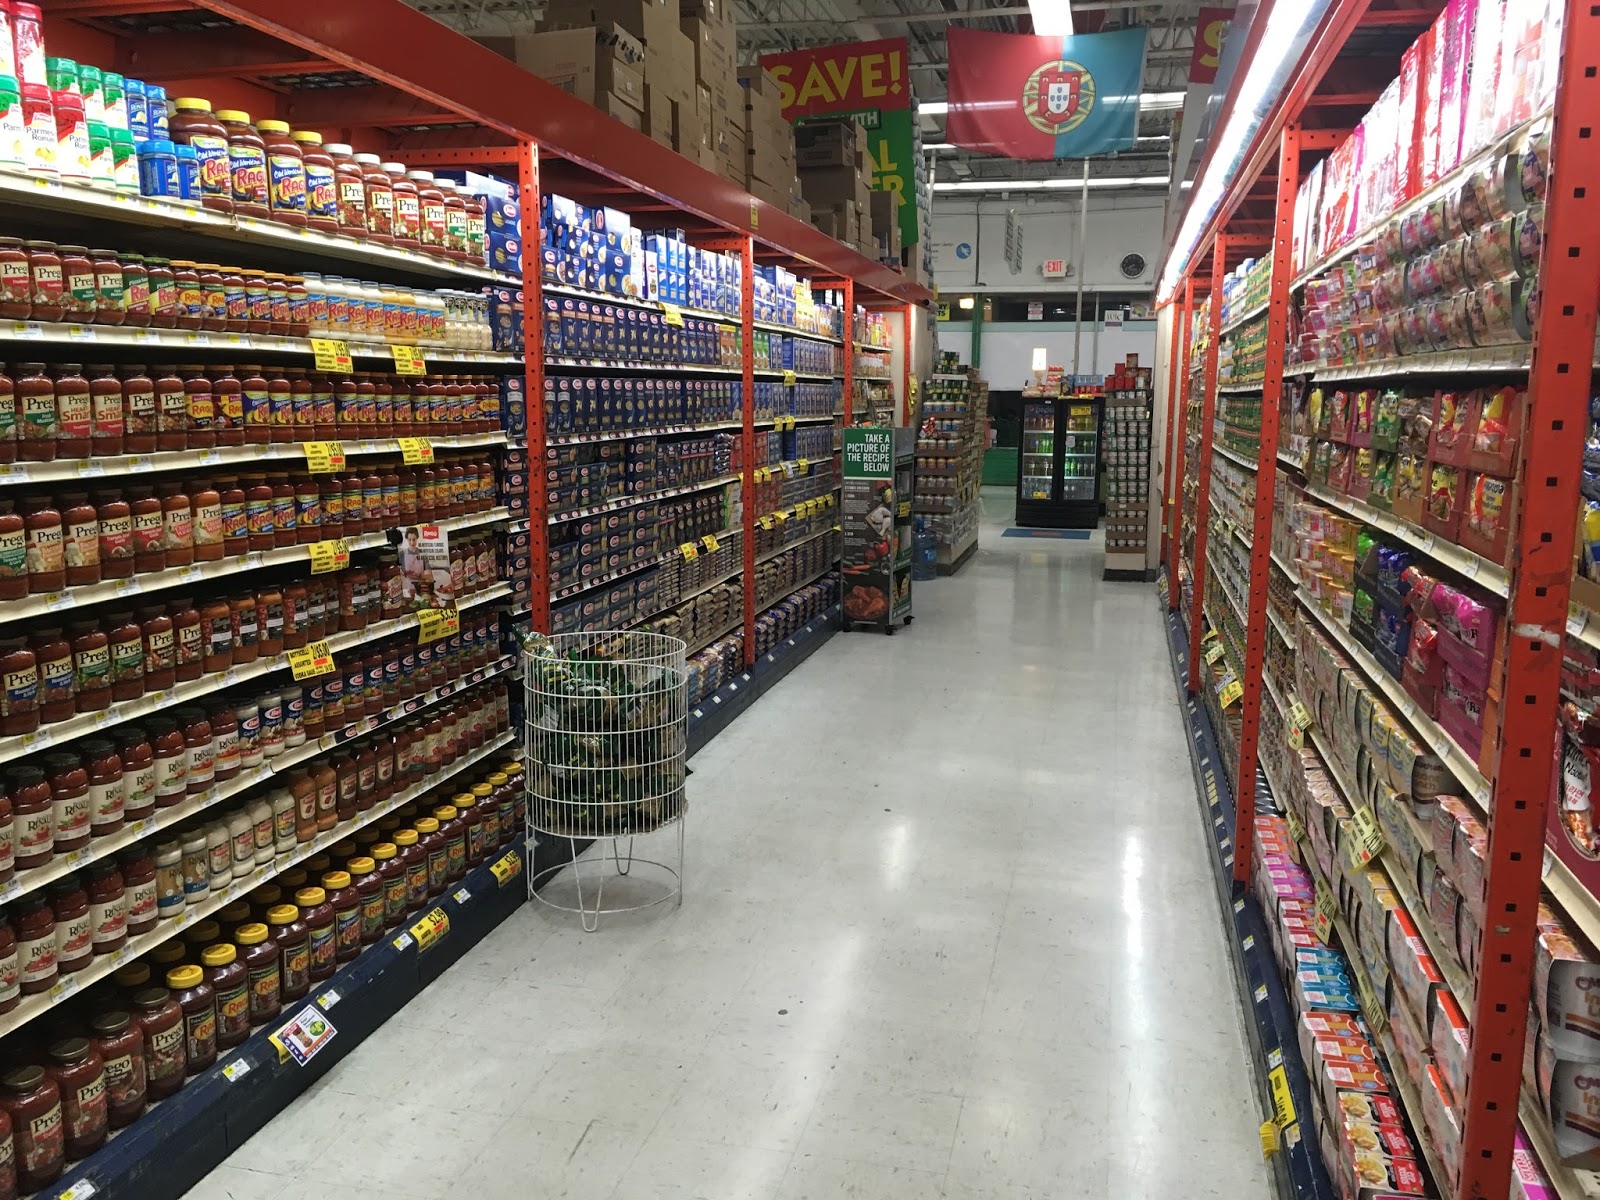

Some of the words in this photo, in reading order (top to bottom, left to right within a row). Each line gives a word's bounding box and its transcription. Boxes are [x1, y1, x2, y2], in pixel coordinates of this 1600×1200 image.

[767, 51, 902, 109] SAVE!
[1047, 261, 1063, 272] EXIT
[865, 433, 883, 443] TAKE
[884, 433, 890, 443] A
[847, 443, 879, 453] PICTURE
[880, 443, 890, 453] OF
[847, 453, 862, 462] THE
[863, 453, 889, 463] RECIPE
[863, 462, 890, 472] BELOW
